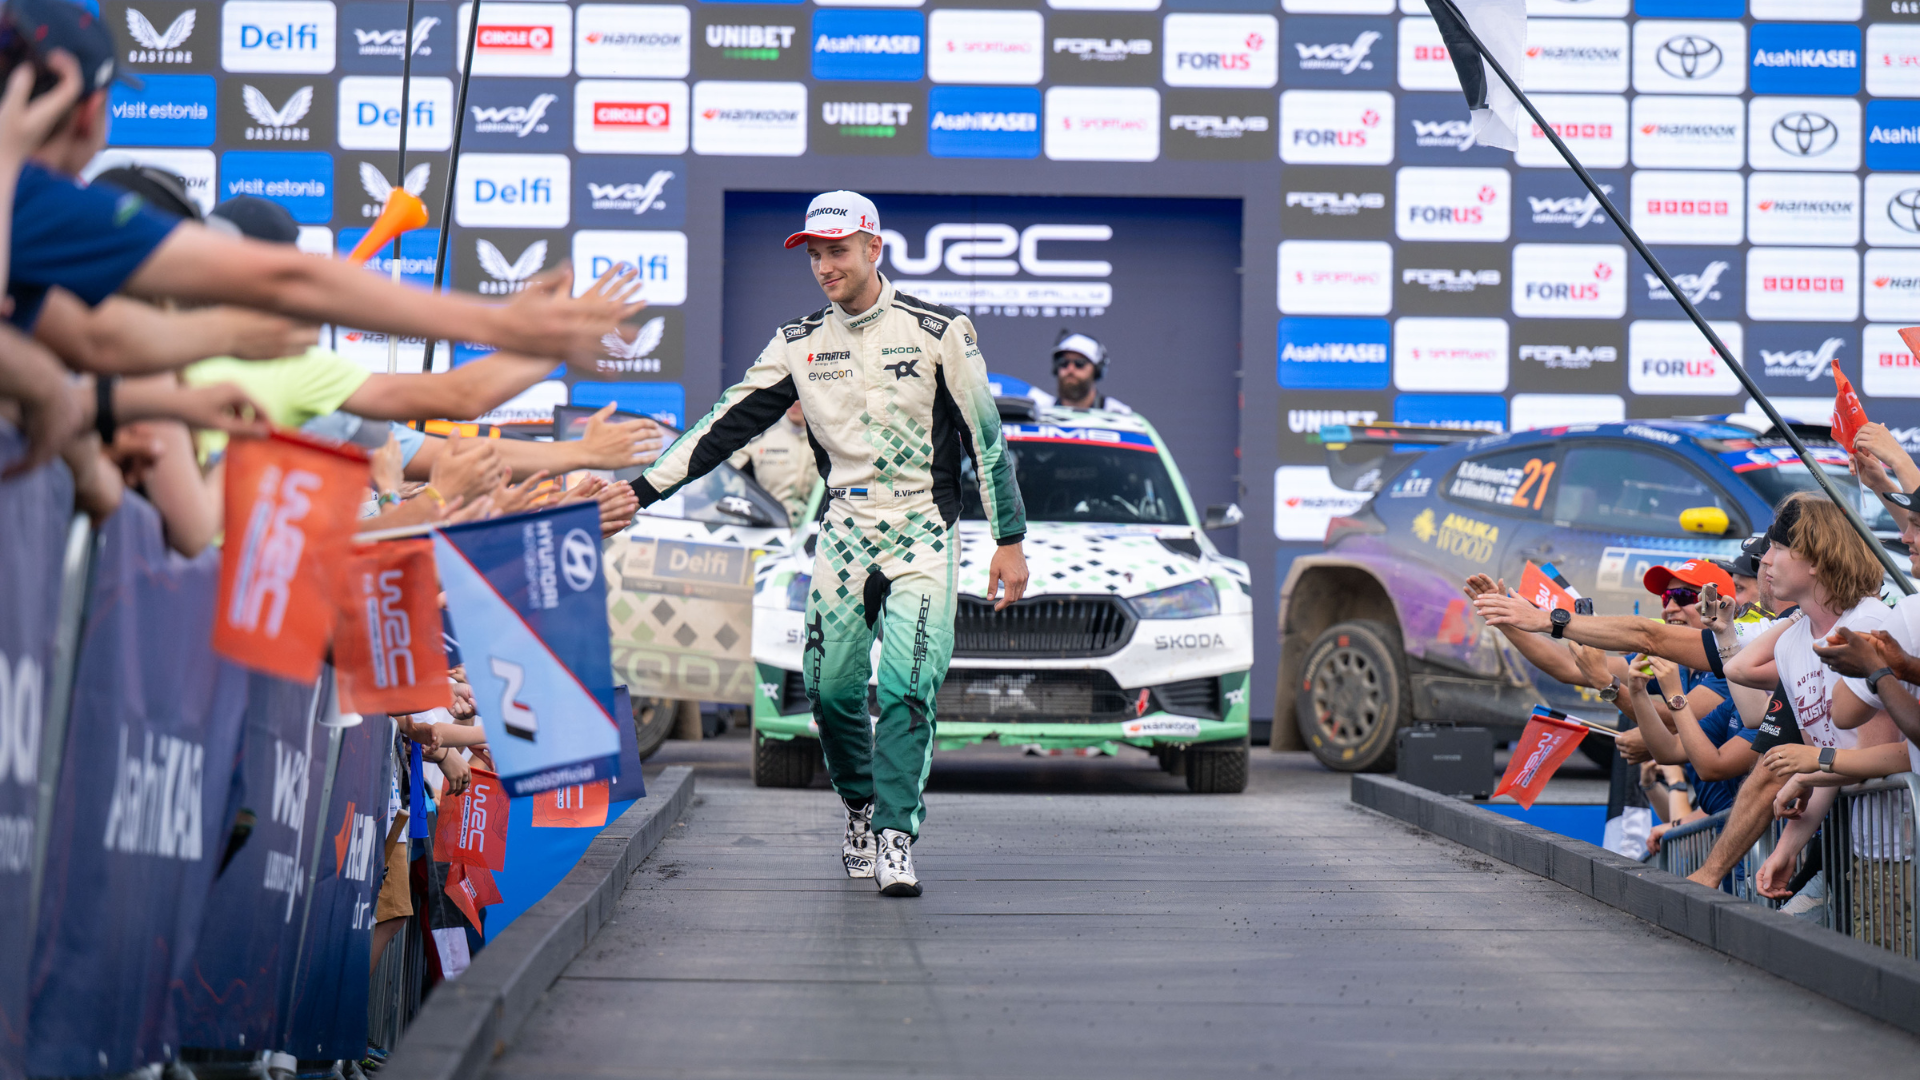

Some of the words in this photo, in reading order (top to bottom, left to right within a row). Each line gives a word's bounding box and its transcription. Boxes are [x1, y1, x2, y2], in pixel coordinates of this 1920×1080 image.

[241, 24, 318, 50] Delfi
[480, 30, 528, 45] CIRCLE
[706, 25, 795, 48] UNIBET
[1177, 53, 1251, 70] FORUS
[1753, 49, 1857, 68] AsahiKASEI
[112, 102, 148, 120] visit
[149, 103, 208, 121] estonia
[357, 101, 434, 127] Defi
[597, 108, 645, 122] CIRCLE
[822, 102, 911, 126] UNIBET
[1294, 129, 1367, 147] FORUS
[229, 179, 265, 196] visit
[266, 180, 325, 198] estonia
[475, 177, 551, 203] Delfi
[860, 215, 875, 231] 1st
[1410, 206, 1483, 223] FORUS
[876, 223, 1113, 277] WRC
[1526, 282, 1599, 300] FORUS
[786, 327, 806, 338] OMP
[922, 319, 943, 331] OMP
[808, 369, 853, 381] evecon
[1642, 359, 1716, 377] FORUS
[1511, 458, 1557, 511] 21
[536, 520, 559, 610] HYUNDAI
[669, 549, 729, 576] Delfi
[379, 569, 416, 688] WRC
[909, 594, 930, 698] TOKSPORT
[468, 784, 490, 853] WRC
